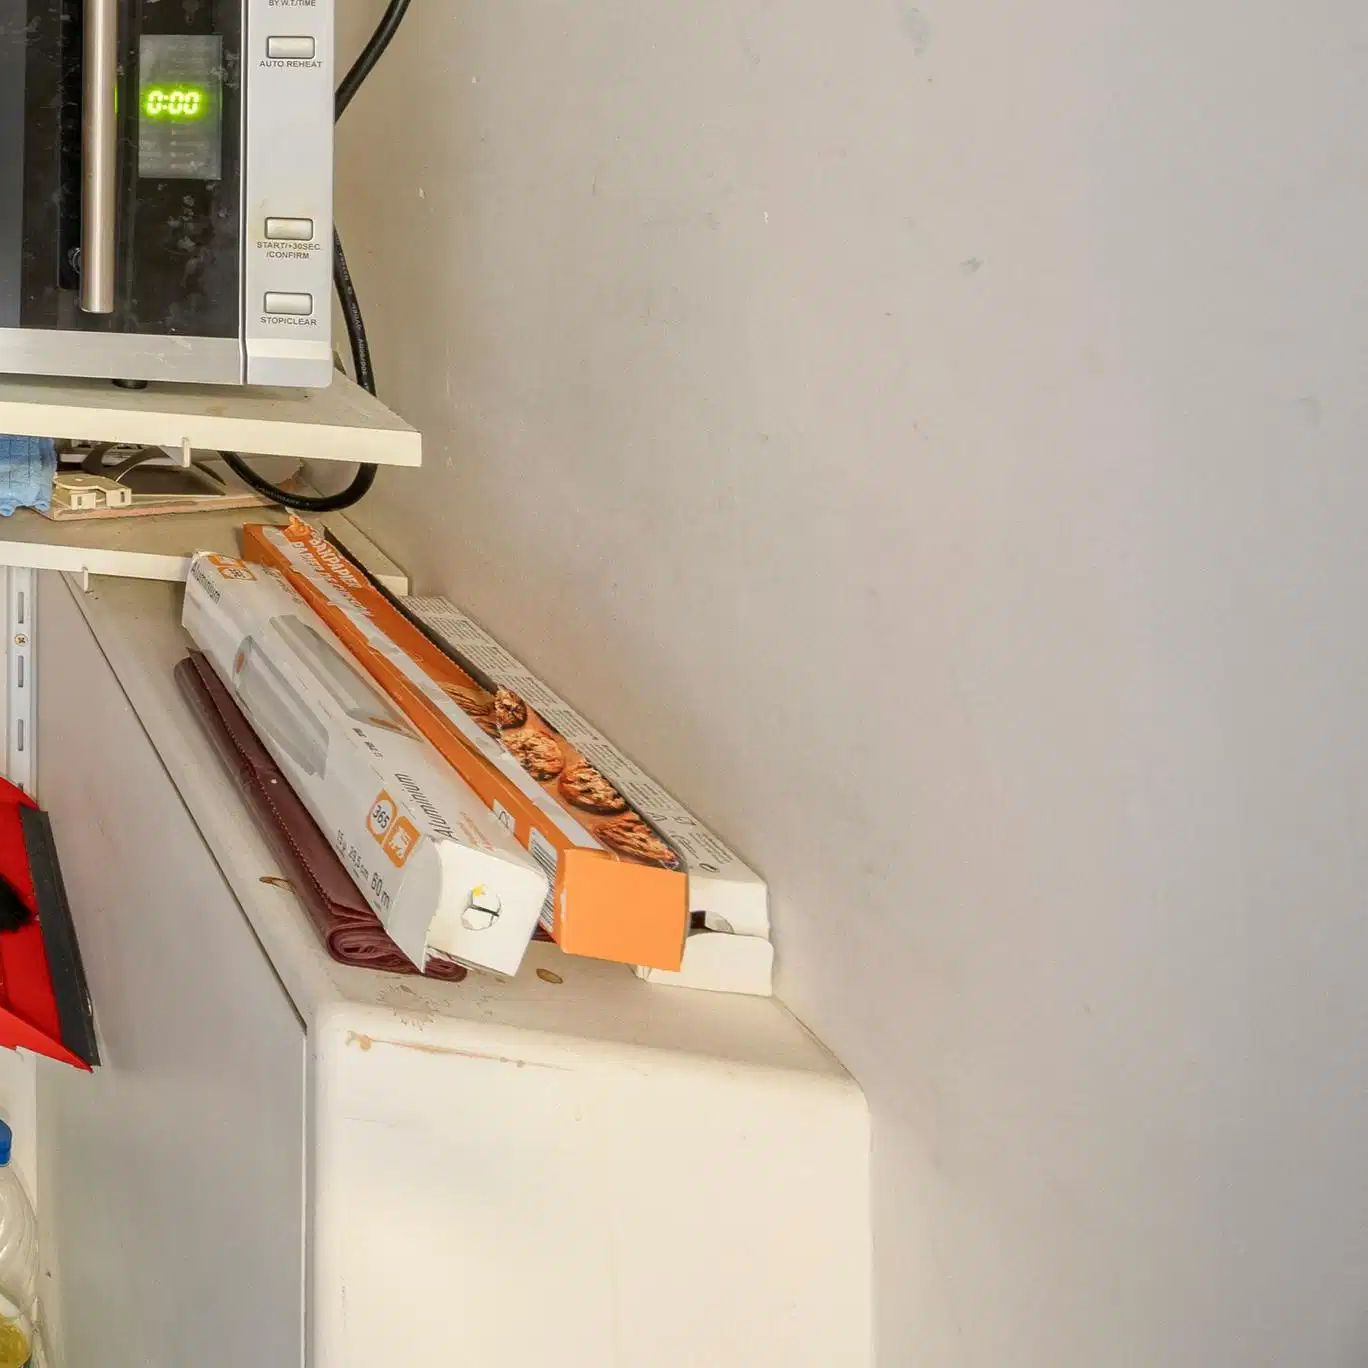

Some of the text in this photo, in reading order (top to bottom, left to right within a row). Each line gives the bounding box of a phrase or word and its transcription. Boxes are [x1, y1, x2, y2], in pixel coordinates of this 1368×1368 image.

[268, 0, 278, 7] BY
[259, 60, 323, 69] AUTO REHEAT
[146, 90, 201, 115] 0:00
[260, 316, 318, 326] STOP/CLEAR
[190, 561, 222, 605] Aluminium
[372, 804, 390, 829] 365
[395, 773, 460, 842] Aluminium
[371, 872, 384, 897] 60
